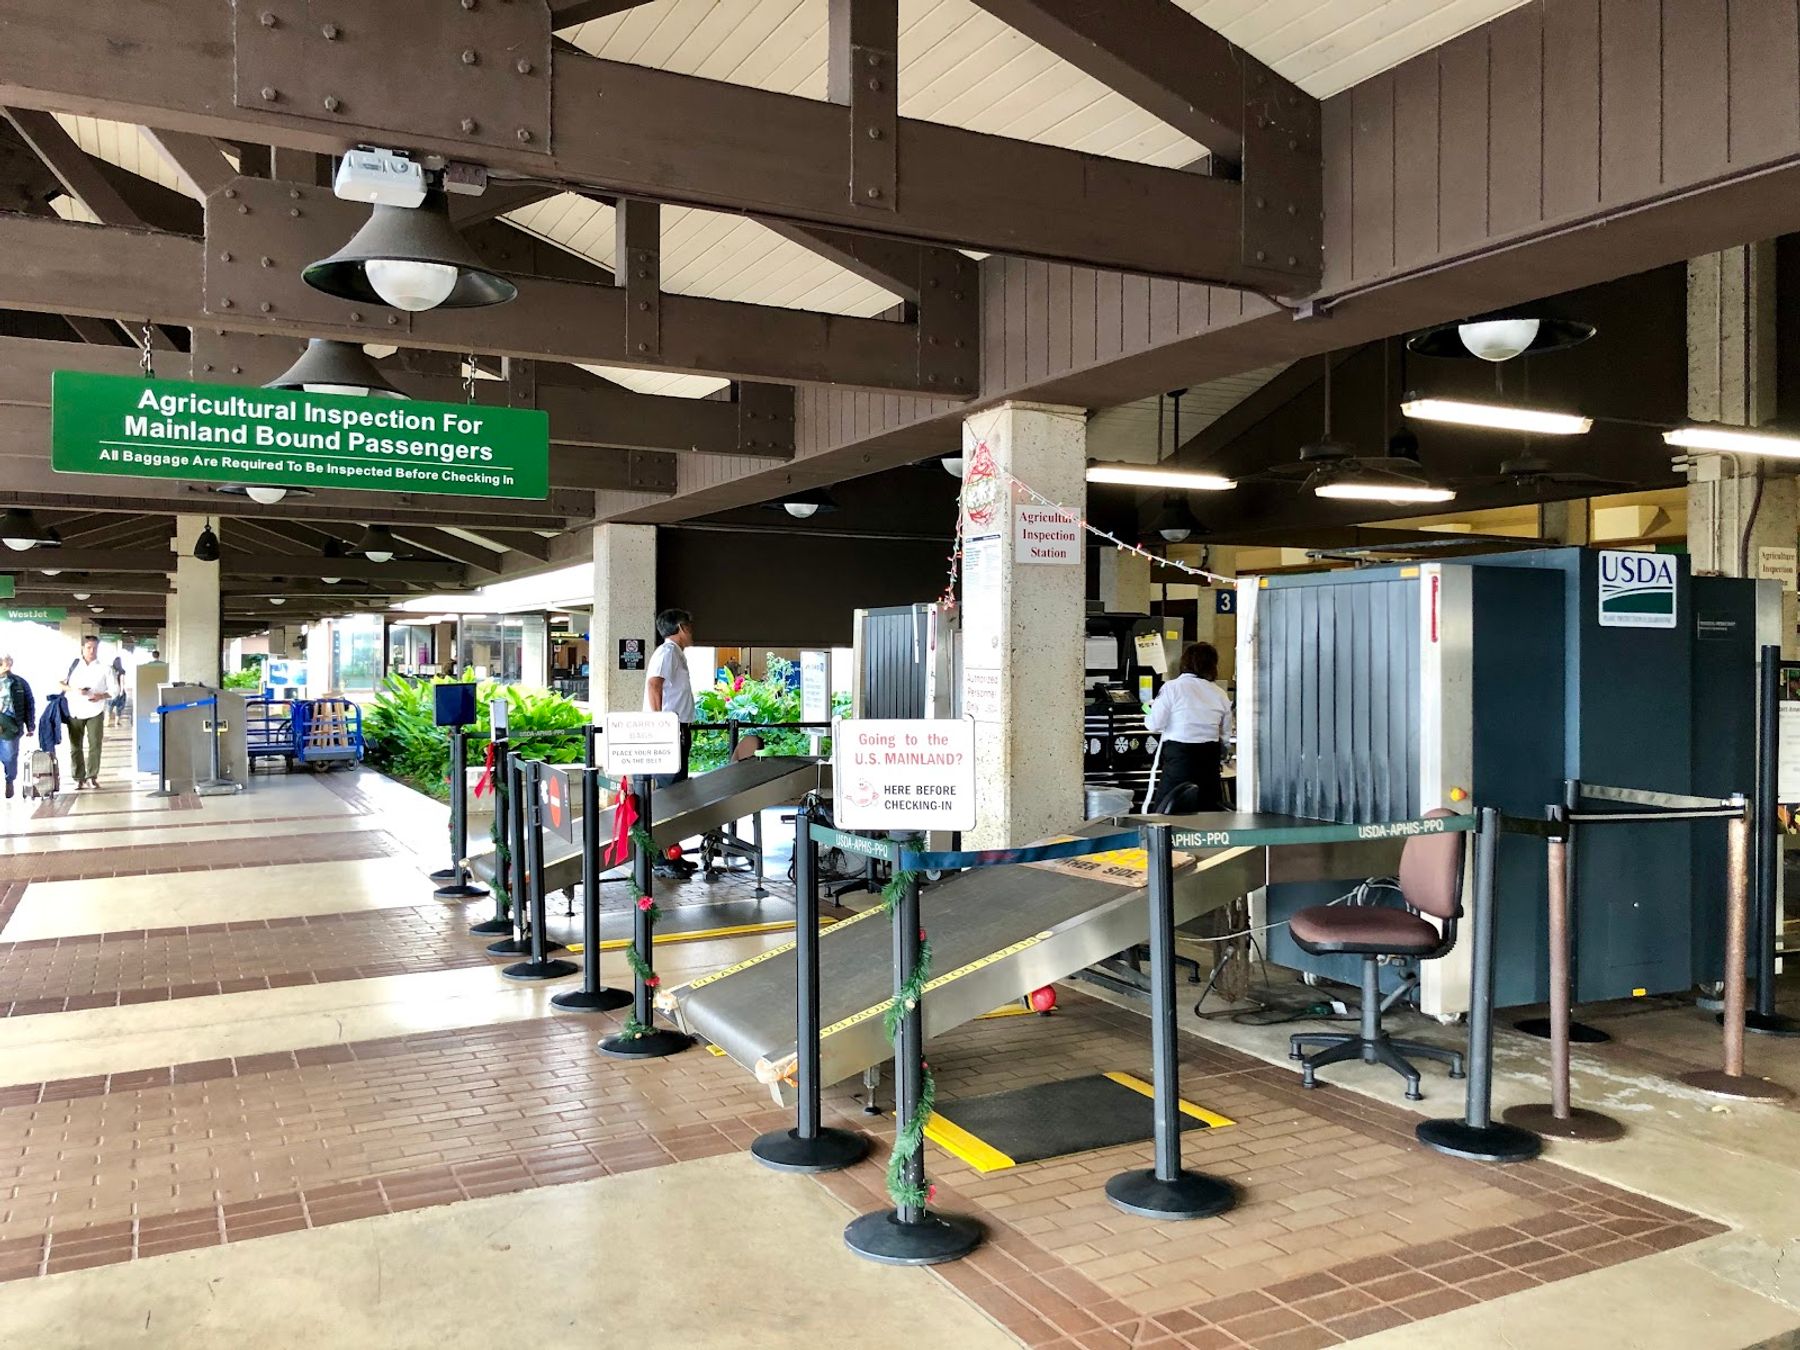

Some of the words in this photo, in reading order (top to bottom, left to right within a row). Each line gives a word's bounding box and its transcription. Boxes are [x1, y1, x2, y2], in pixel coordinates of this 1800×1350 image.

[137, 389, 296, 421] Agricultural
[304, 402, 436, 431] Inspection
[443, 413, 483, 435] For
[124, 415, 248, 444] Mainland
[255, 425, 341, 451] Bound
[348, 431, 493, 463] Passengers
[99, 449, 119, 461] All
[122, 450, 189, 467] Baggage
[192, 455, 218, 467] Are
[221, 457, 283, 472] Required
[286, 460, 303, 472] To
[305, 463, 324, 474] Be
[327, 463, 392, 479] Inspected
[395, 467, 439, 481] Before
[441, 470, 500, 487] Checking
[502, 474, 514, 485] In
[1019, 511, 1079, 525] Agricultur
[1022, 528, 1076, 543] Inspection
[1030, 547, 1067, 558] Station
[1602, 555, 1673, 584] USDA
[1220, 592, 1232, 611] 3
[8, 610, 47, 618] WestJet
[858, 733, 897, 749] Going
[905, 733, 918, 746] to
[927, 733, 949, 746] the
[611, 749, 633, 757] PLACE
[634, 749, 652, 757] YOUR
[854, 752, 881, 766] U.S.
[884, 752, 964, 766] MAINLAND?
[883, 785, 911, 795] HERE
[915, 785, 957, 796] BEFORE
[884, 799, 953, 811] CHECKING-IN
[1358, 818, 1445, 839] USDA-APHIS-PPQ
[835, 833, 889, 858] USDA-APHIS-PPQ
[1102, 866, 1143, 879] SIDE
